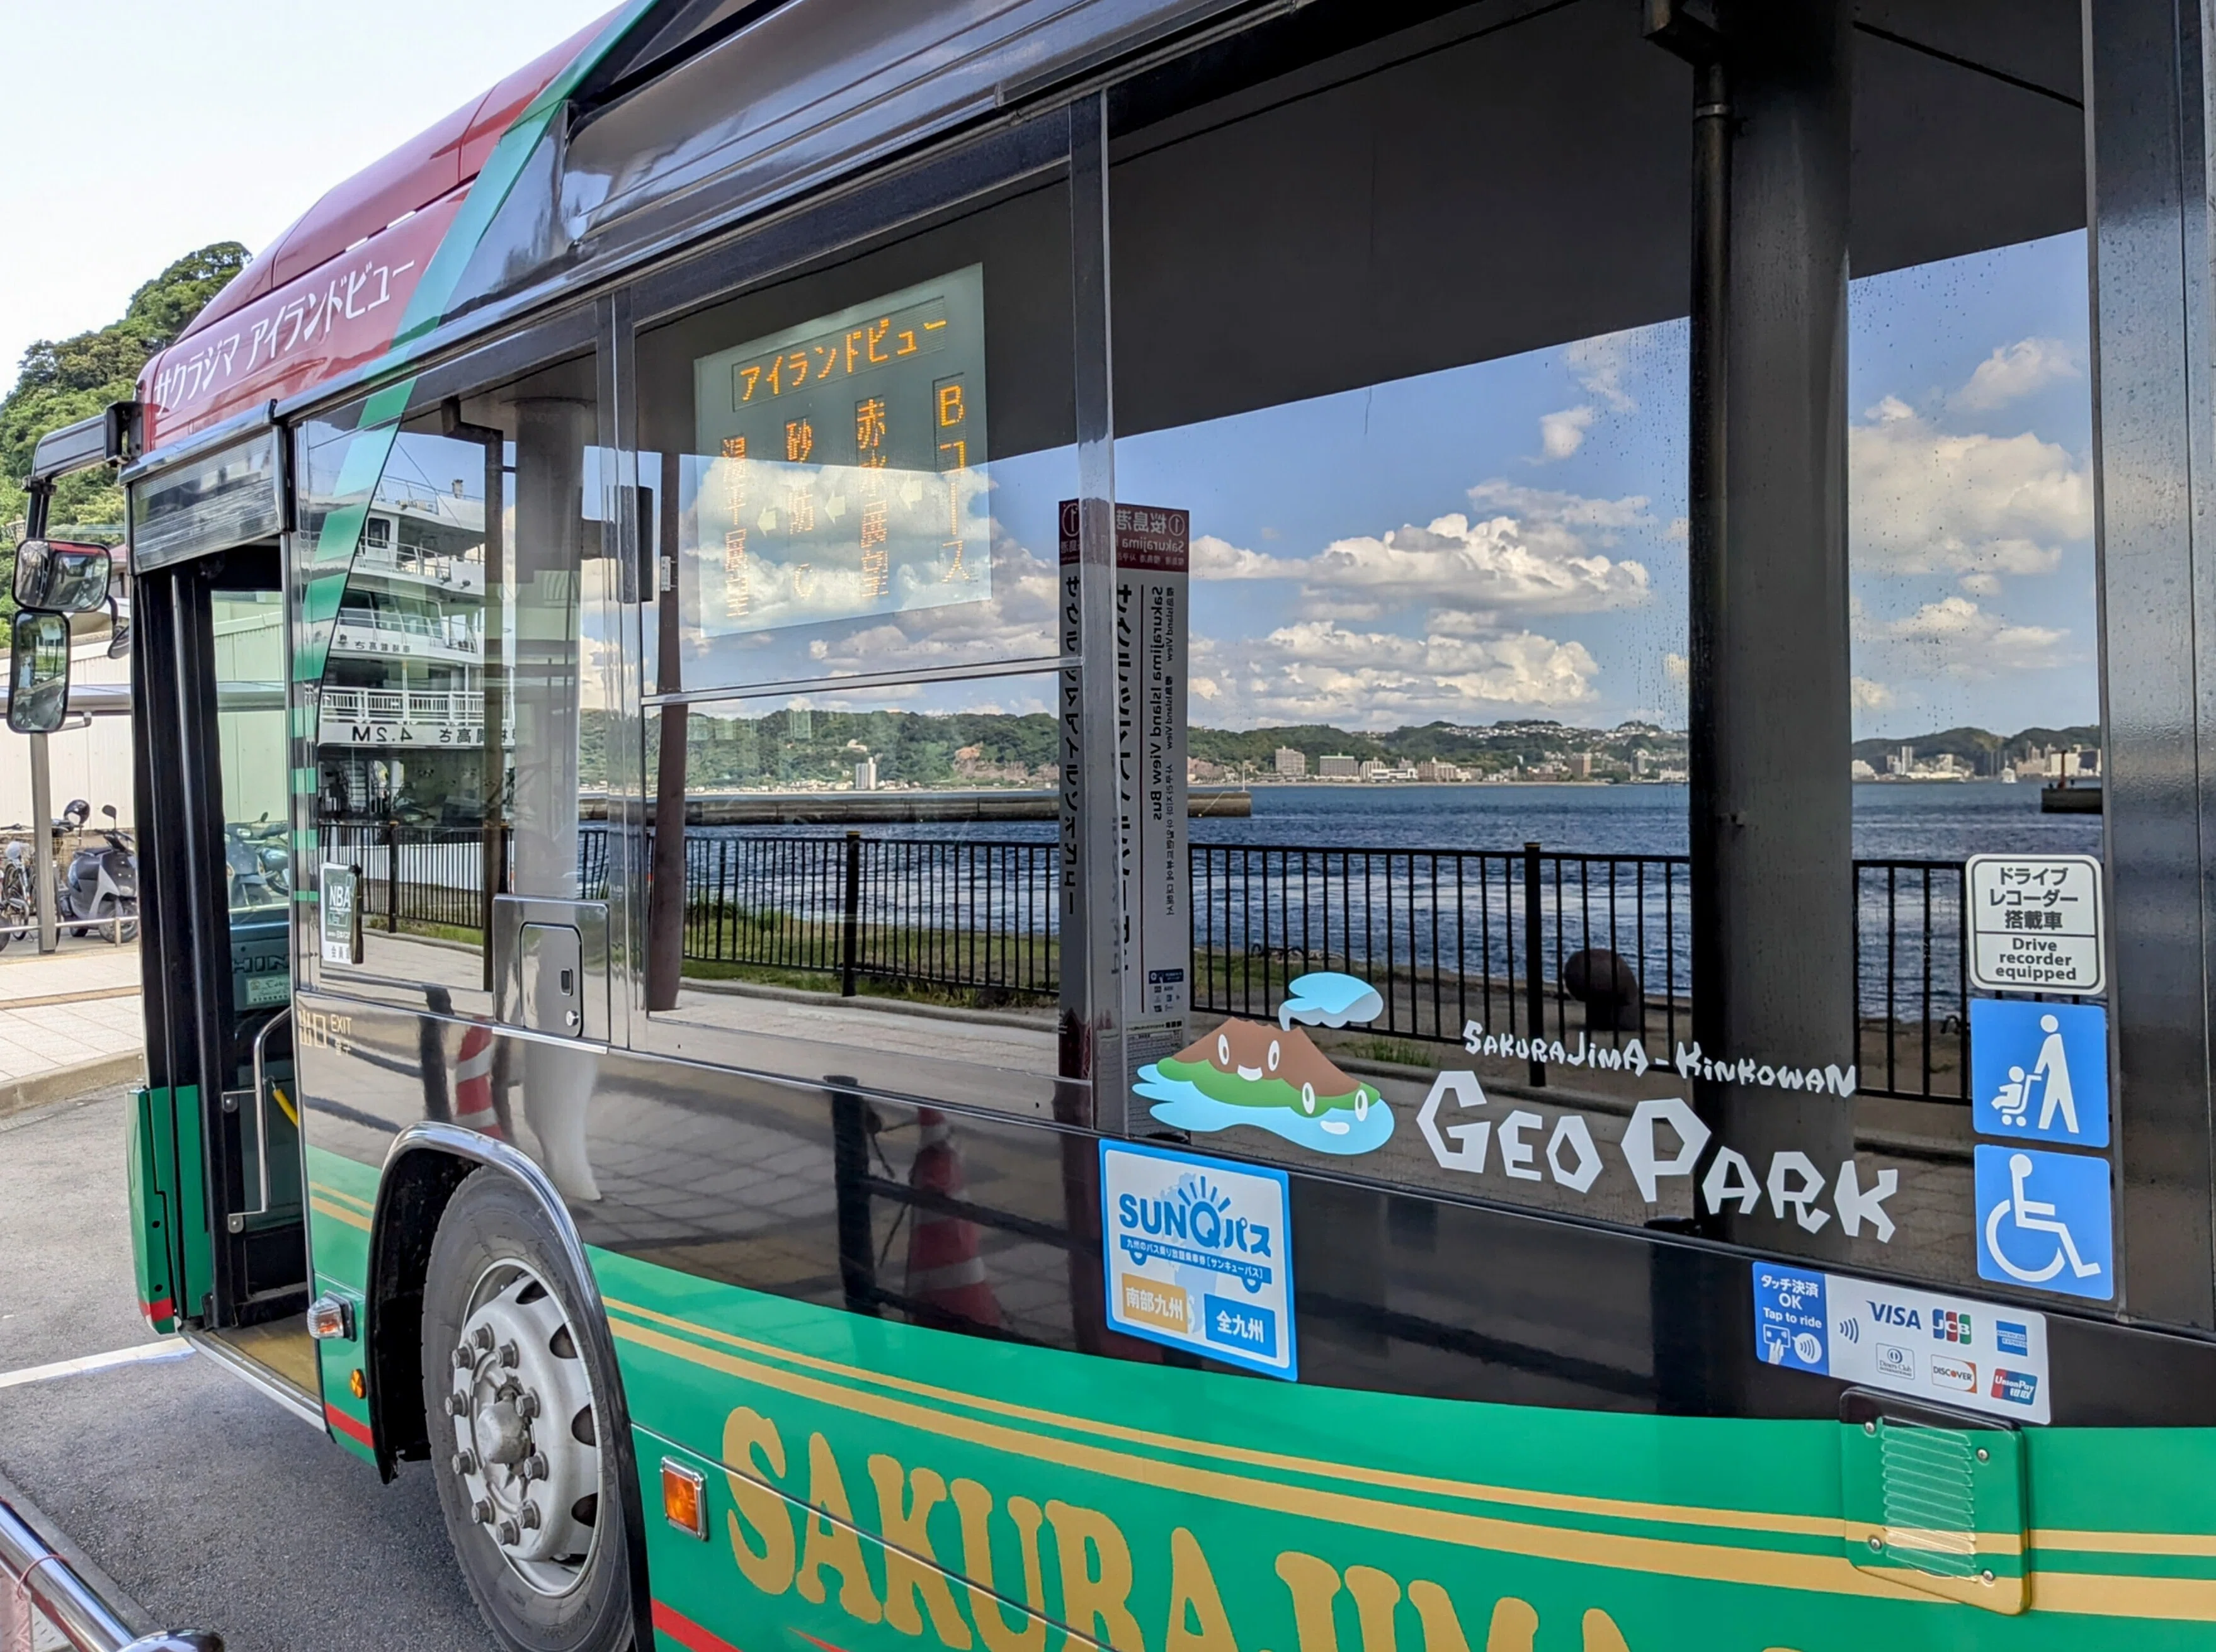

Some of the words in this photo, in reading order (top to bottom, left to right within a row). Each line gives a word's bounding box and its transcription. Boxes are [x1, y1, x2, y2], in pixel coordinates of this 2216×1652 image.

[155, 333, 241, 417] サクラジマ
[246, 260, 414, 370] アイランドビュー
[741, 319, 946, 402] アイランドビュー
[939, 384, 969, 583] Bコース
[2000, 867, 2069, 886] ドライブ
[329, 885, 351, 908] NBA
[1990, 888, 2078, 908] レコーダー
[2005, 910, 2063, 931] 搭載車
[2013, 937, 2057, 951] Drive
[1999, 953, 2072, 966] recorder
[1996, 966, 2077, 982] equipped
[298, 1009, 327, 1049] 出口
[331, 1014, 352, 1034] EXIT
[1416, 1070, 1604, 1194] GEO
[1621, 1097, 1899, 1243] PARK
[1118, 1193, 1272, 1258] SUNQパス
[1761, 1274, 1819, 1298] タッチ決済
[1125, 1286, 1185, 1321] 南部九州
[1778, 1293, 1804, 1311] OK
[1763, 1307, 1783, 1323] Tap
[1785, 1311, 1798, 1324] to
[1800, 1315, 1822, 1329] ride
[1866, 1300, 1922, 1330] VISA
[1216, 1310, 1264, 1343] 全九州
[1997, 1330, 2026, 1340] AMERICAN
[2003, 1337, 2028, 1348] EXPRESS
[1880, 1360, 1897, 1371] Diners
[1899, 1364, 1912, 1373] Club
[1933, 1365, 1973, 1381] DISCOVER
[1995, 1375, 2035, 1393] UnionPay
[722, 1406, 1631, 1652] SAKURA
